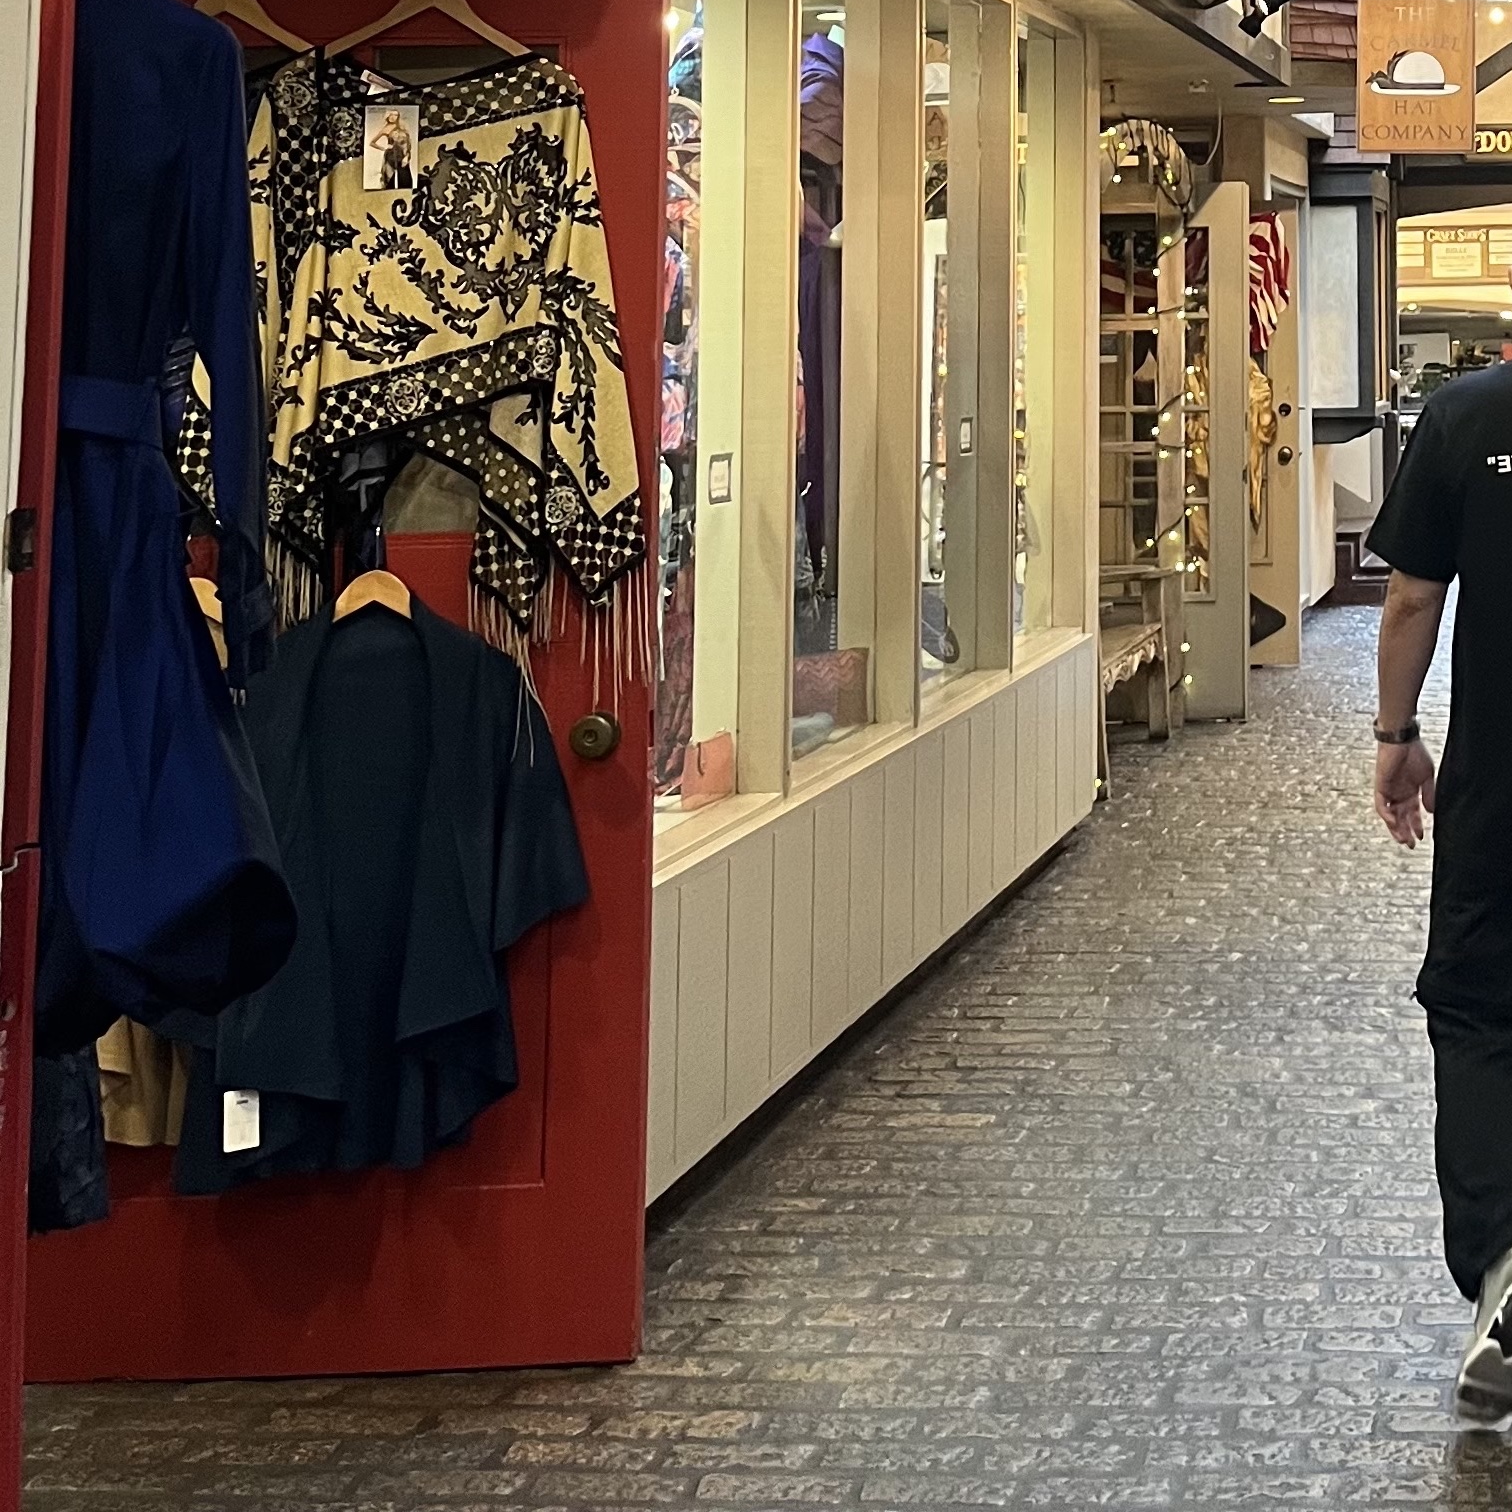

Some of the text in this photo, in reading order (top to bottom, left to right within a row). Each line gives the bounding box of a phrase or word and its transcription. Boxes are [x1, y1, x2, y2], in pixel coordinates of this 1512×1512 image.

[1394, 6, 1435, 22] THE
[1394, 100, 1436, 115] HAT
[1361, 125, 1468, 140] COMPANY
